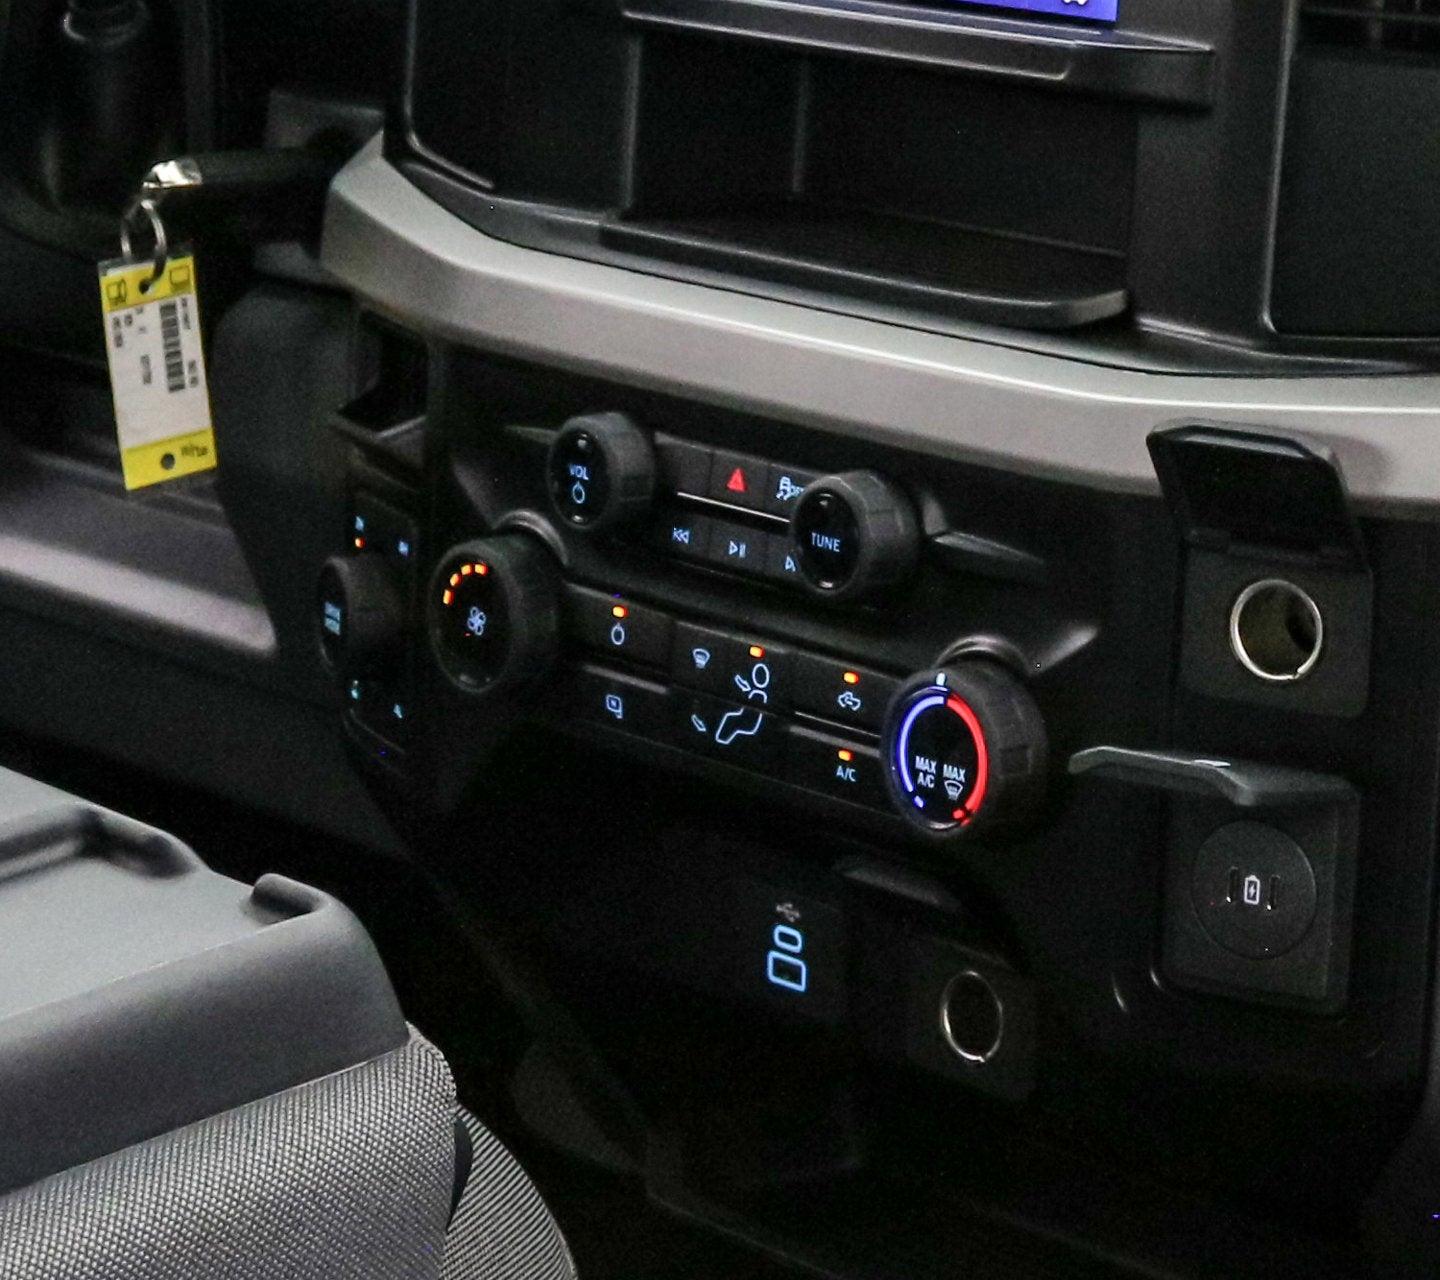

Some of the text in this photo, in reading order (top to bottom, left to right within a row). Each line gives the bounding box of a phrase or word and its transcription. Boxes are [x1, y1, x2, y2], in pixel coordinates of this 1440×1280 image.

[569, 464, 589, 480] VOL
[811, 531, 841, 553] TUNE
[836, 765, 857, 782] A/C
[915, 755, 937, 774] MAX
[943, 764, 966, 783] MAX
[917, 771, 935, 788] A/C
